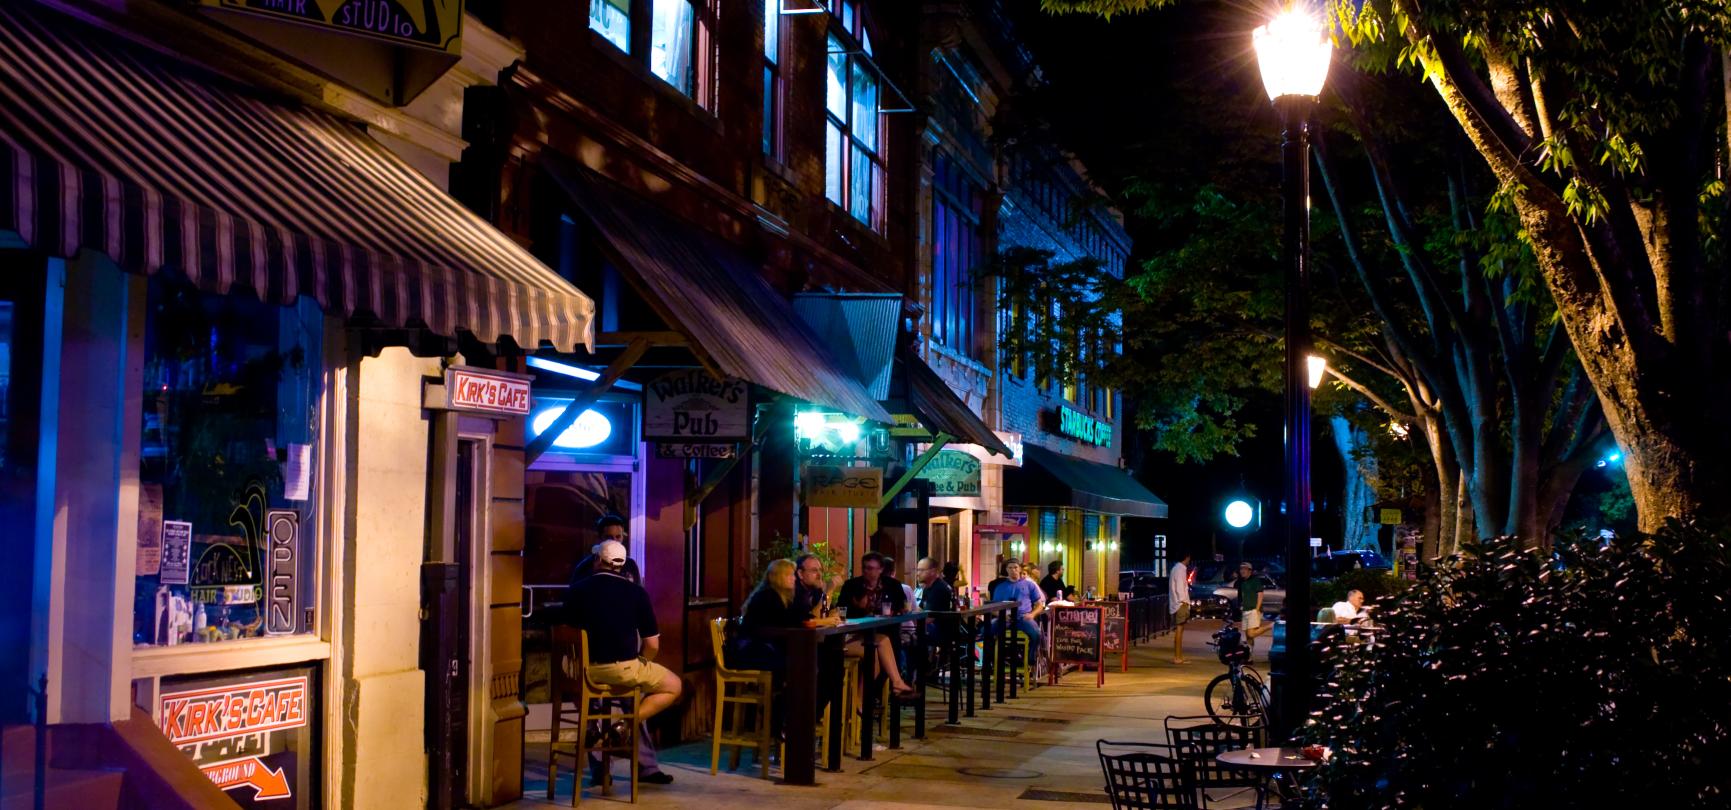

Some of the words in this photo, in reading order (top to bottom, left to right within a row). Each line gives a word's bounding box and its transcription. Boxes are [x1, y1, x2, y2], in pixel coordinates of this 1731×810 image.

[341, 0, 414, 37] STUDIO
[457, 376, 497, 405] KIRK'S
[498, 382, 528, 409] CAFE
[650, 369, 743, 404] Walker's
[673, 411, 719, 436] Pub
[1060, 404, 1095, 444] STARBUCKS
[946, 481, 954, 492] &
[957, 480, 977, 492] Pub
[271, 517, 294, 629] OPEN
[191, 588, 217, 604] HAIR
[165, 693, 244, 740] KIRK'S
[245, 688, 303, 727] CAFE
